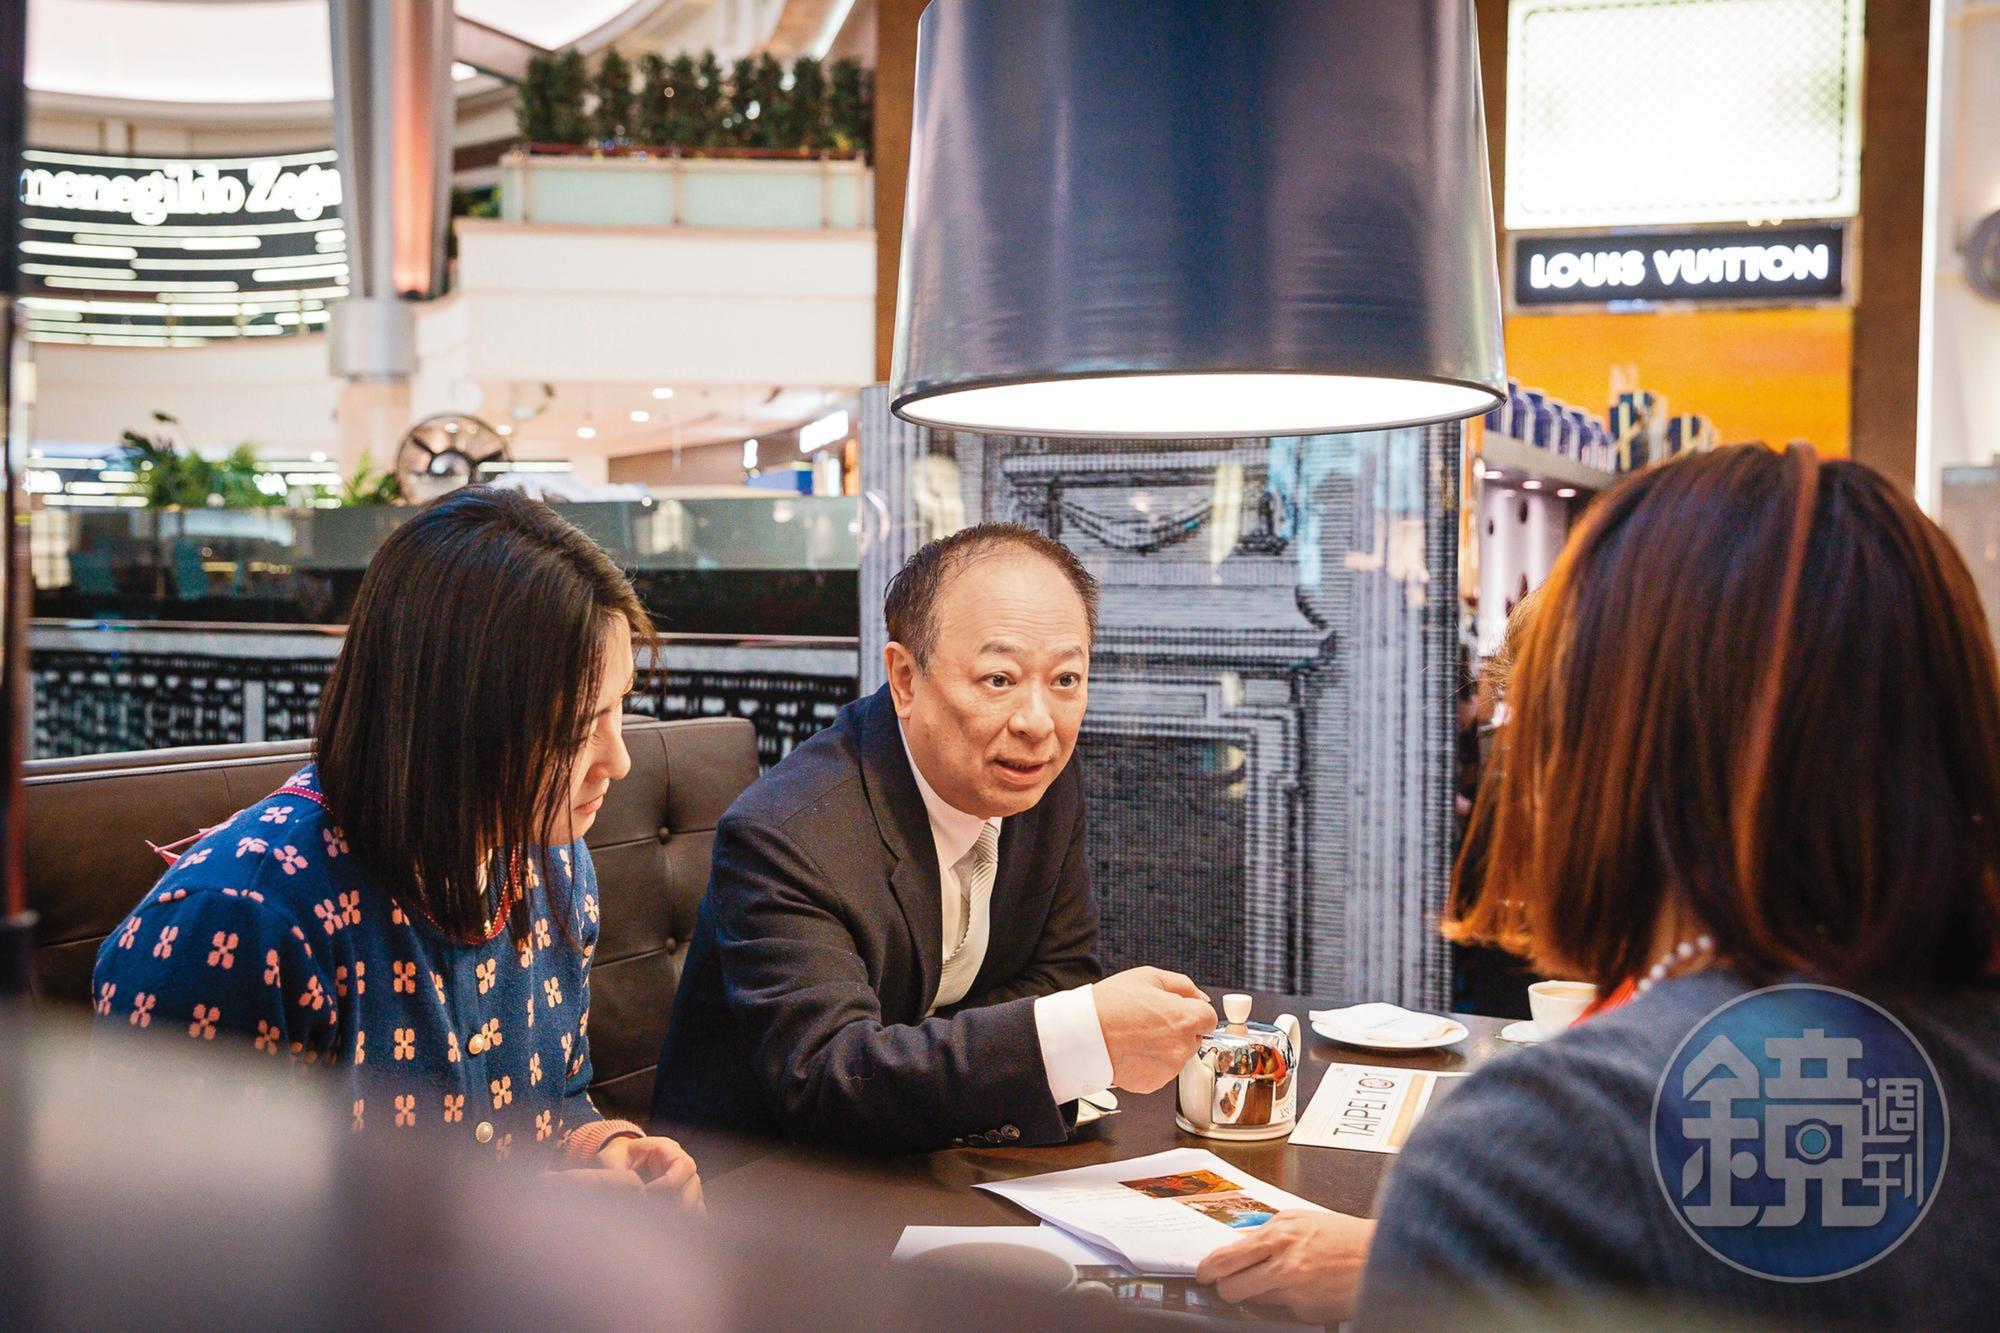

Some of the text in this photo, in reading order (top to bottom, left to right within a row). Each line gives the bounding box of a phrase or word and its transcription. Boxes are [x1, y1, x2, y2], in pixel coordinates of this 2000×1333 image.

[1530, 244, 1829, 289] LOUIS VUITTON
[1332, 1097, 1389, 1137] TAIPEI
